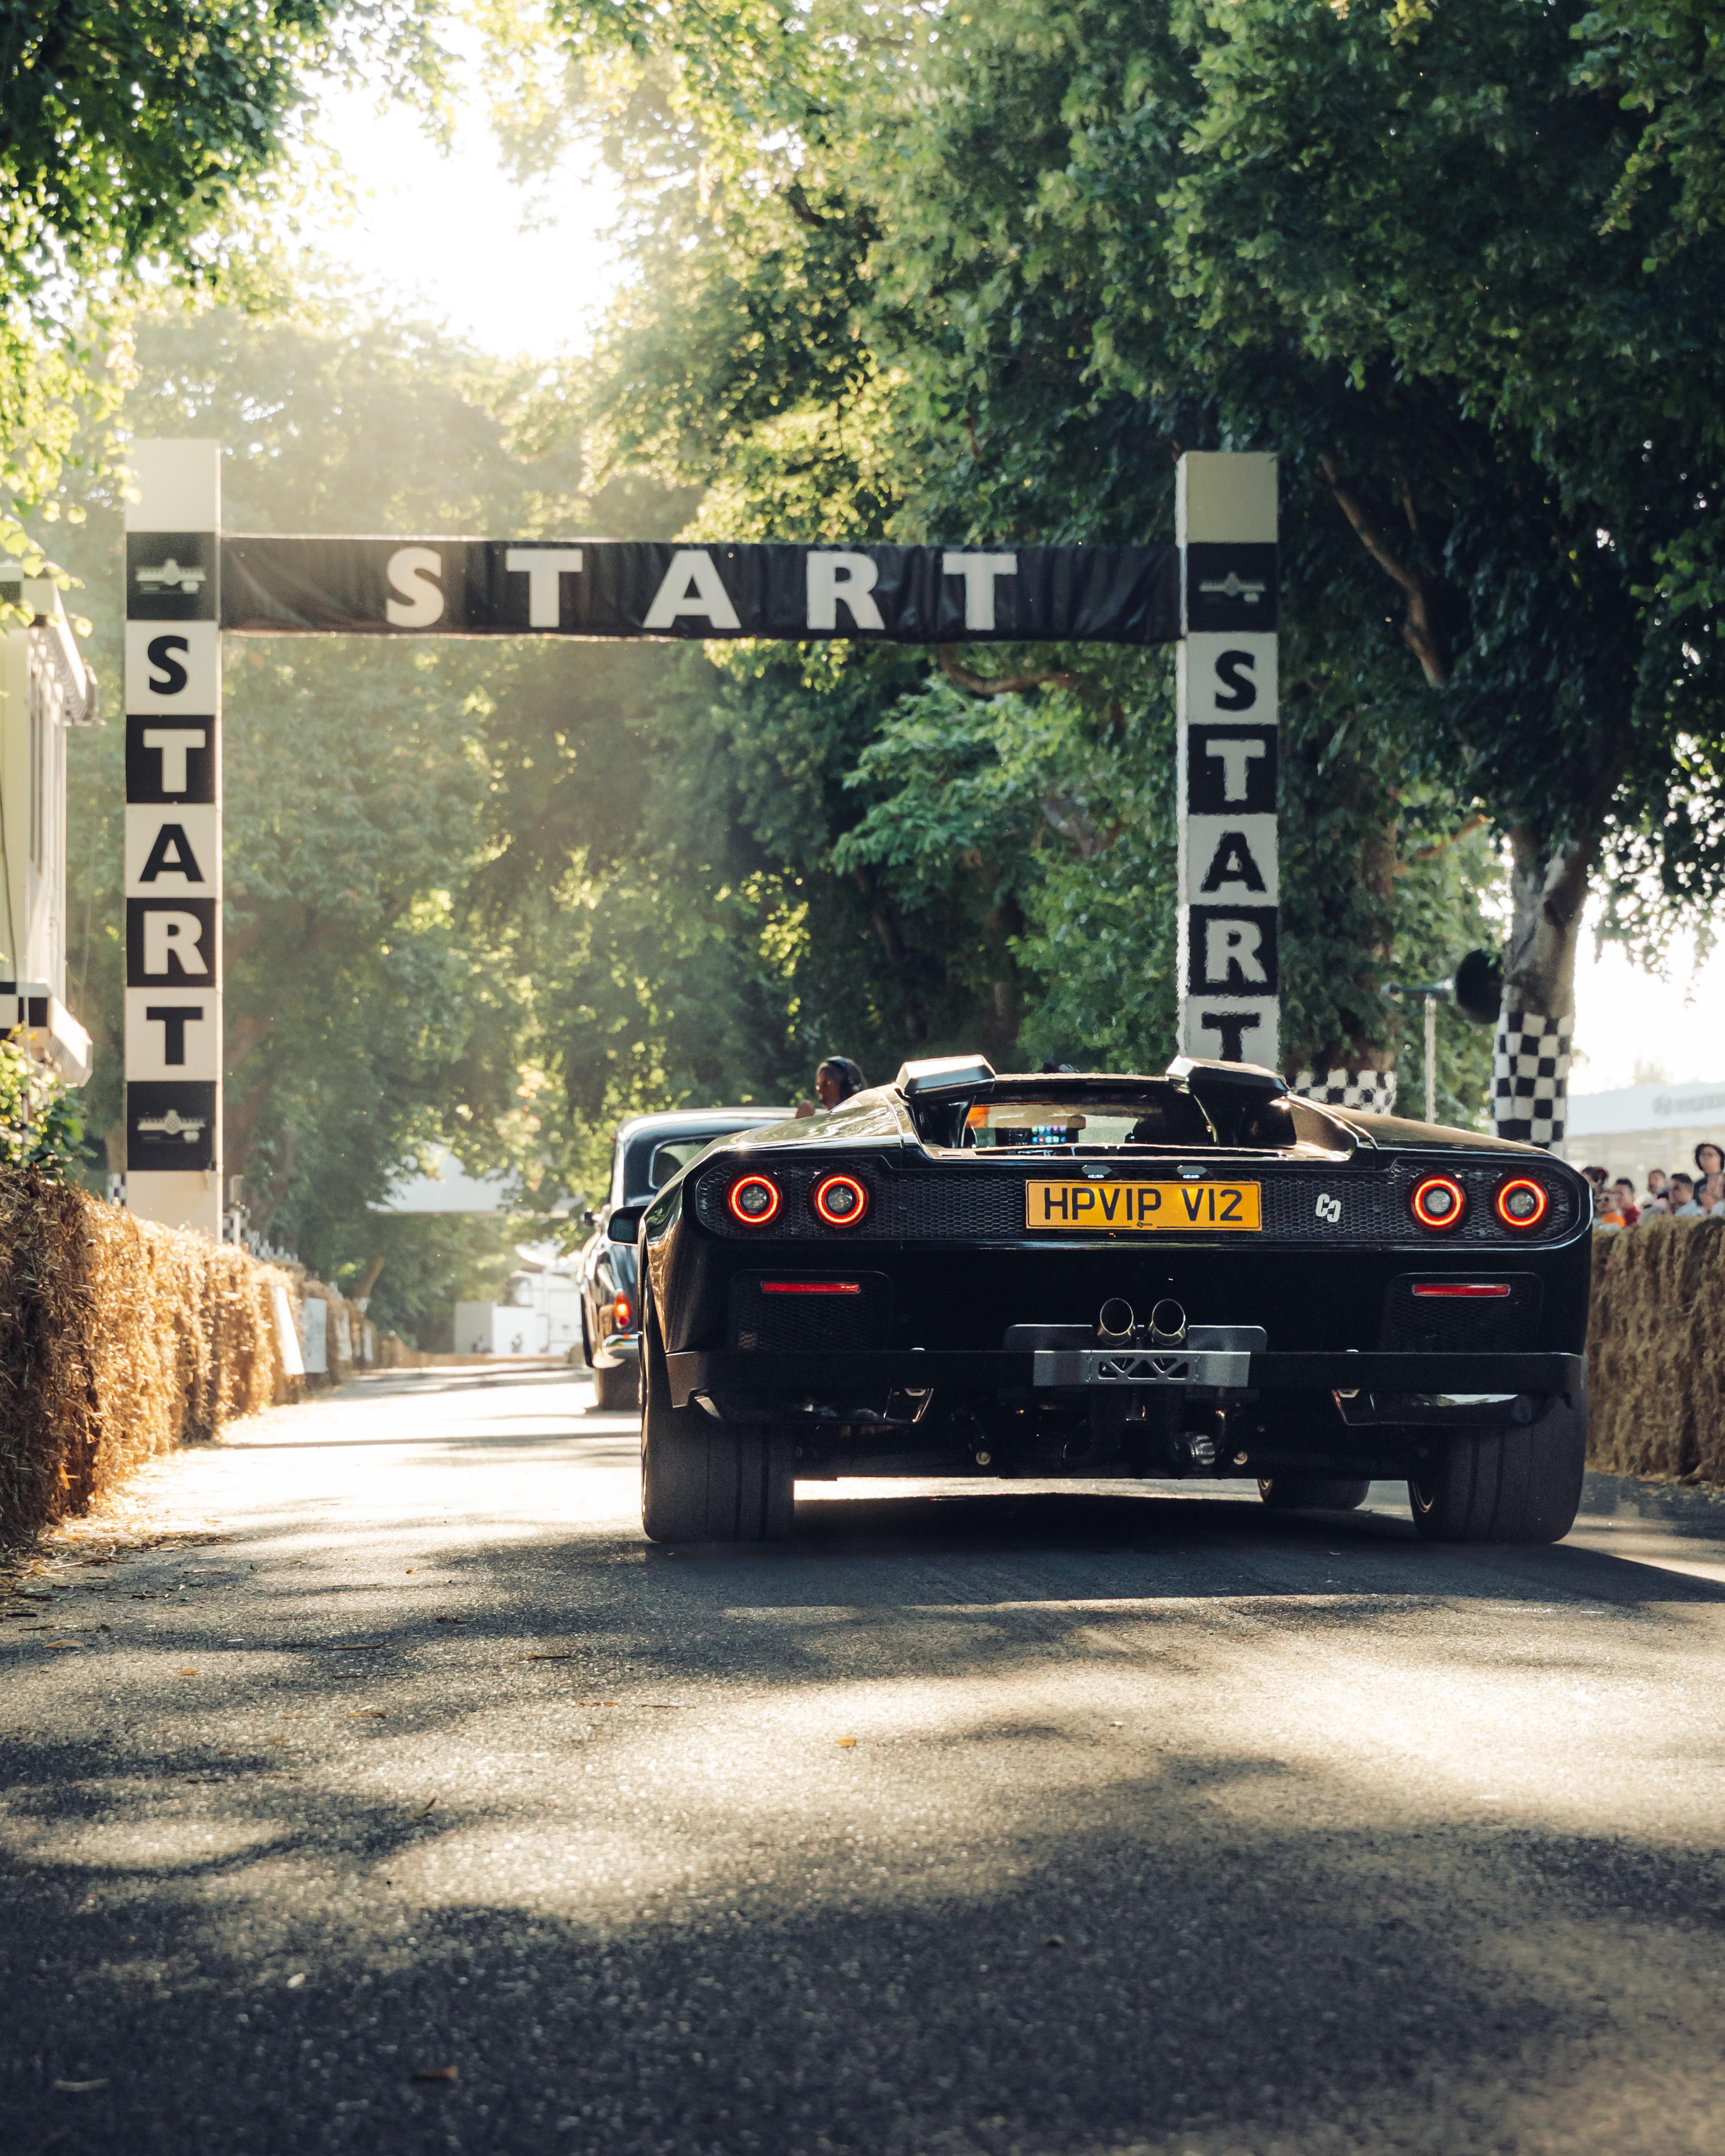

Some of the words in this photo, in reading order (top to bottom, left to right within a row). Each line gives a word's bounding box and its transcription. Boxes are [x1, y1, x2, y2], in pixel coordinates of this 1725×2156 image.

[386, 548, 1017, 630] START
[139, 635, 208, 1065] START
[1201, 650, 1267, 1062] START
